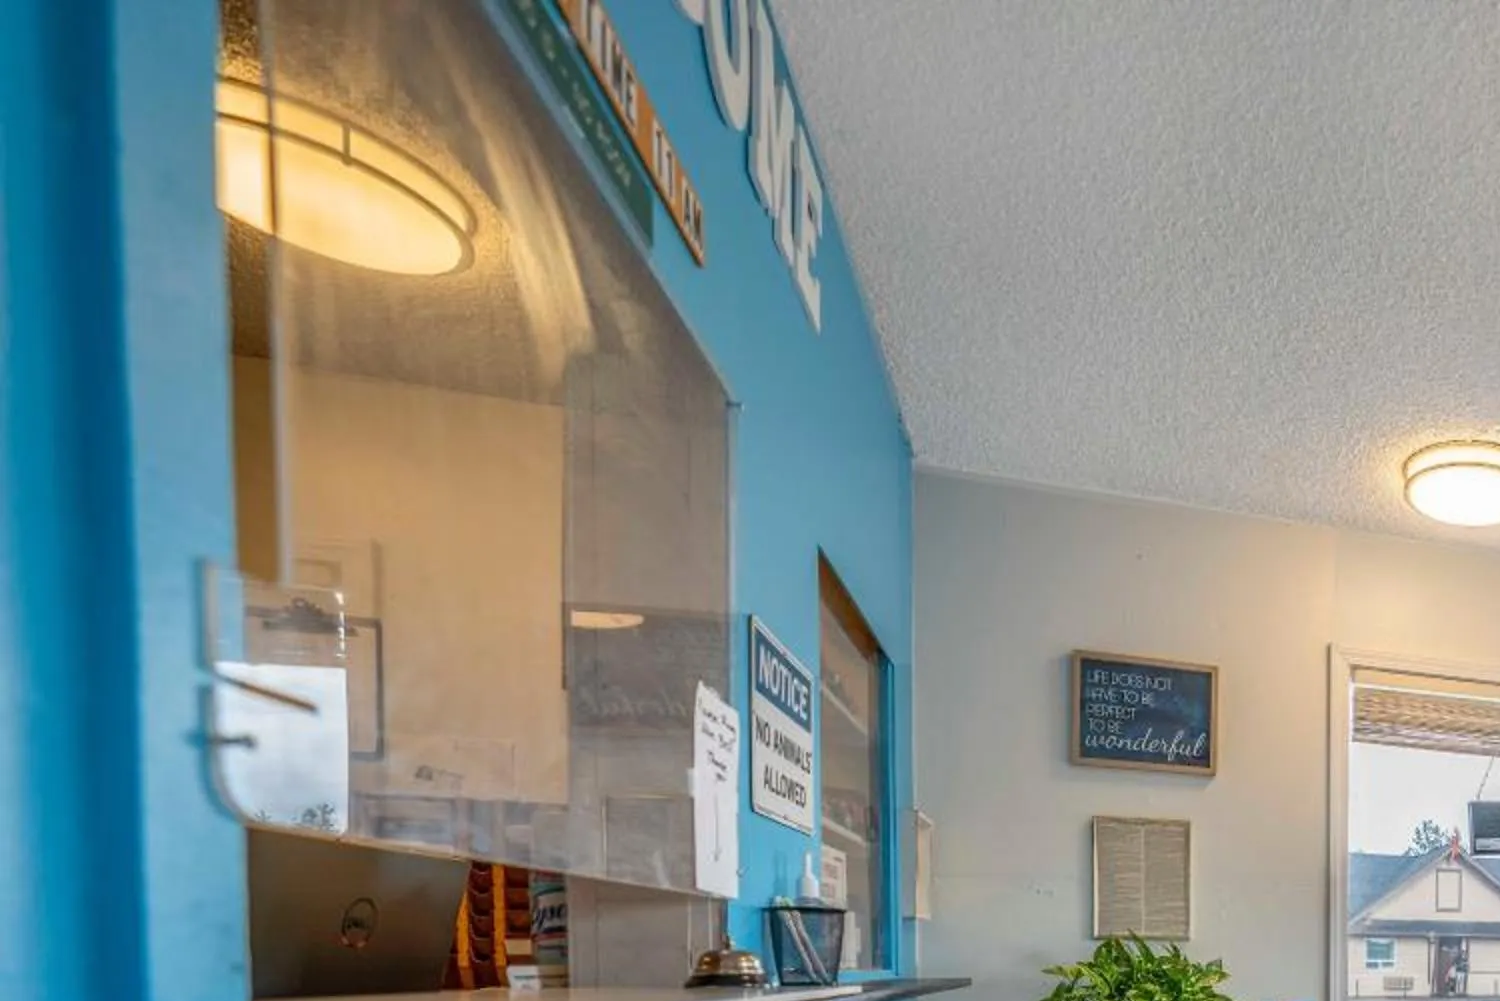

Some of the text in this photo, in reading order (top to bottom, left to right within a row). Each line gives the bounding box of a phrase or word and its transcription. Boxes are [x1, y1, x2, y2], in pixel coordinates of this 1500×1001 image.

[758, 644, 809, 721] NOTICE
[1087, 669, 1172, 691] LIFE DOES NOT
[1087, 687, 1155, 706] HAVE TO BE
[1085, 703, 1137, 720] PERFECT
[1088, 718, 1123, 735] TO BE
[755, 714, 771, 748] NO
[773, 729, 812, 775] ANIMALS
[1084, 727, 1207, 762] wonderful
[763, 763, 807, 809] ALLOWED
